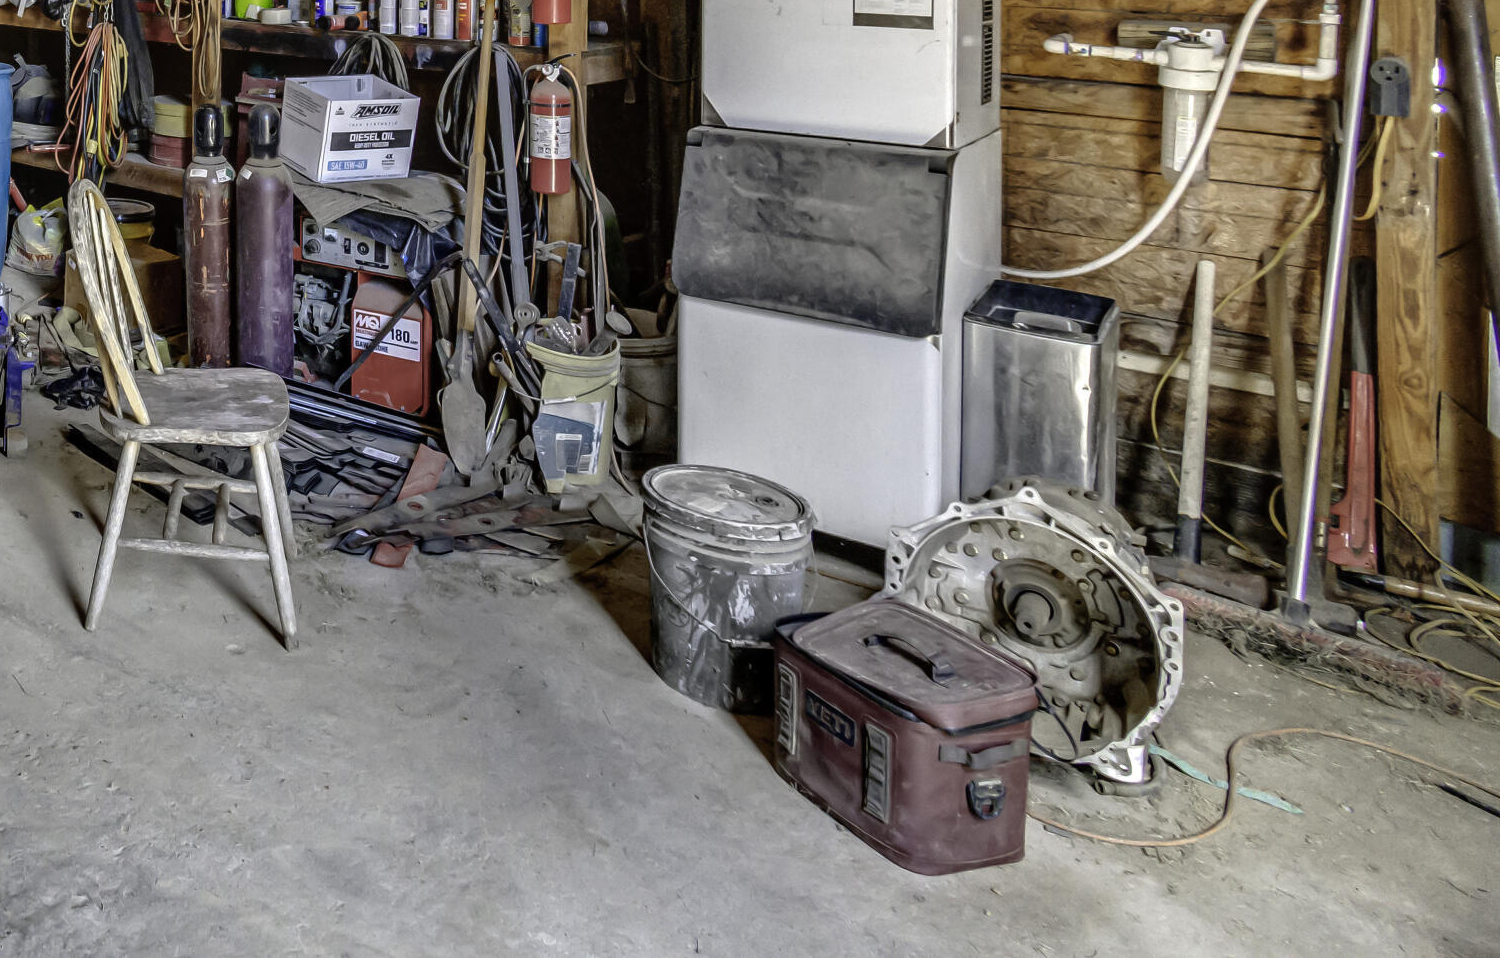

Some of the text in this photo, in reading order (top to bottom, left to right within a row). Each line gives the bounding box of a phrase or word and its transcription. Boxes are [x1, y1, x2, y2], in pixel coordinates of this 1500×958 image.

[354, 105, 400, 118] AMSOIL
[350, 132, 395, 142] DIESEL OIL
